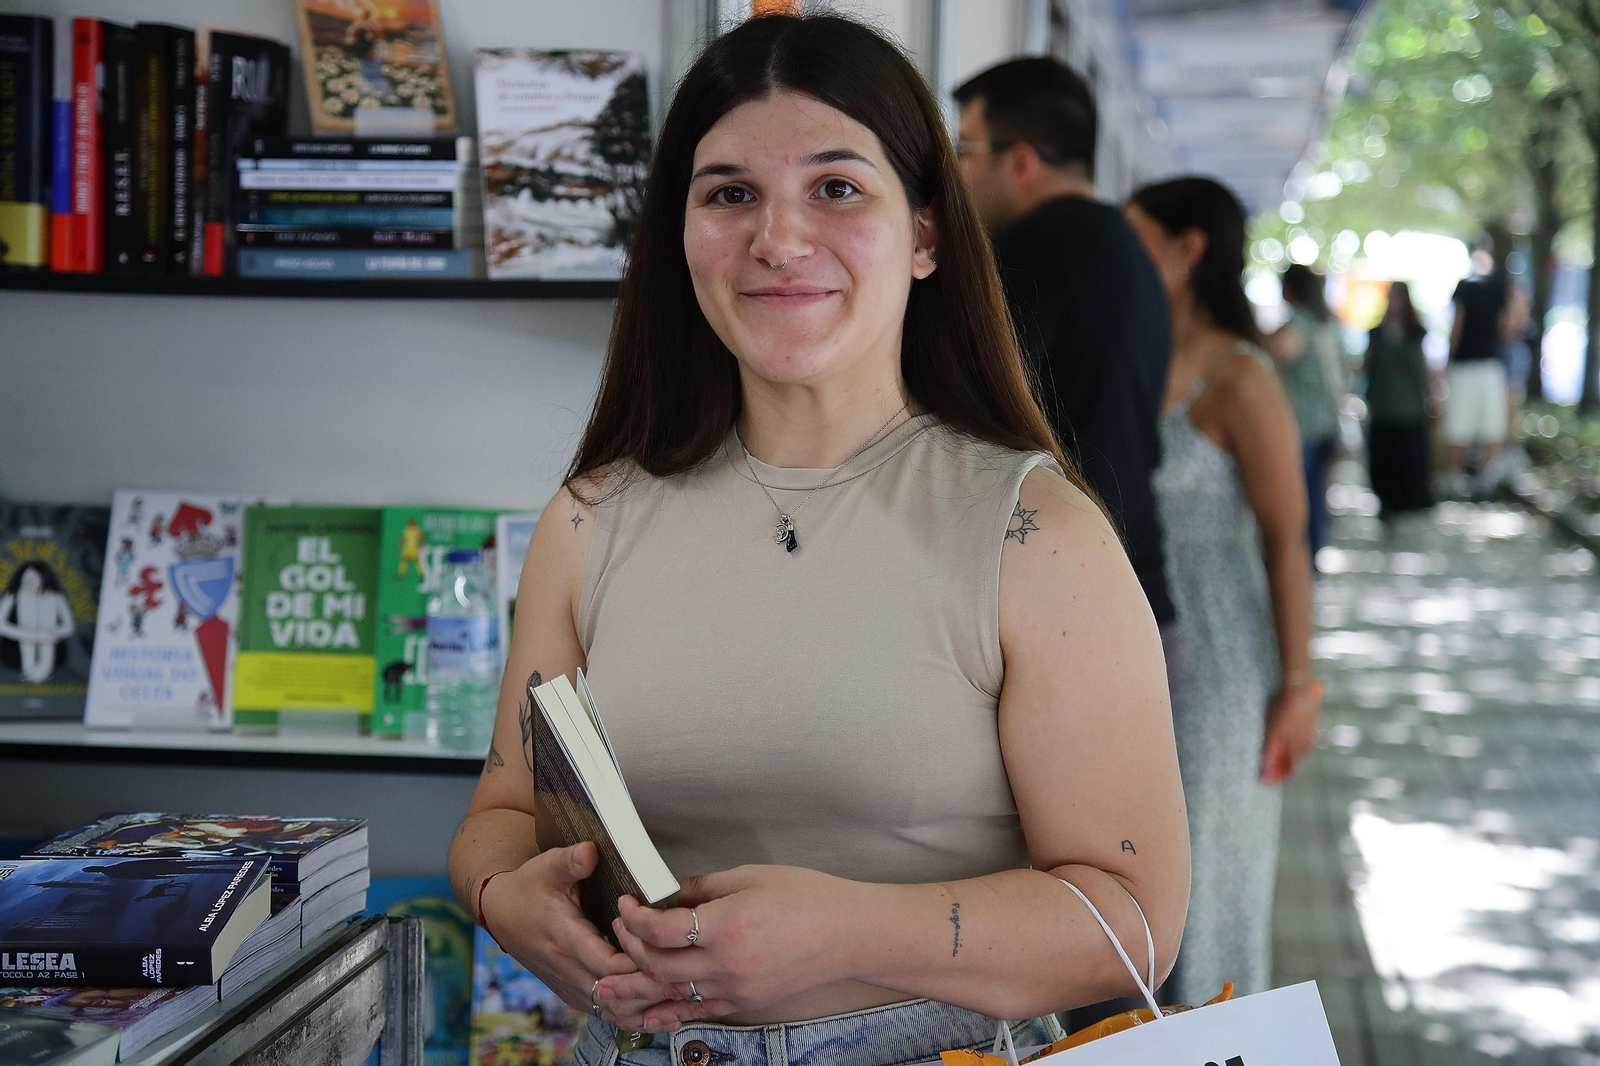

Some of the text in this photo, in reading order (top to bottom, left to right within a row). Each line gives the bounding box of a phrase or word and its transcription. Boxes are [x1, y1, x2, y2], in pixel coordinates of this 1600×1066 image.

[297, 536, 339, 563] EL
[280, 564, 354, 592] GOL
[265, 592, 366, 620] DE MI
[270, 621, 360, 649] VIDA
[1121, 840, 1137, 855] A
[199, 861, 255, 932] ALBA LÓPEZ PAREDES
[54, 971, 78, 979] FASE
[155, 948, 163, 983] PAREDES
